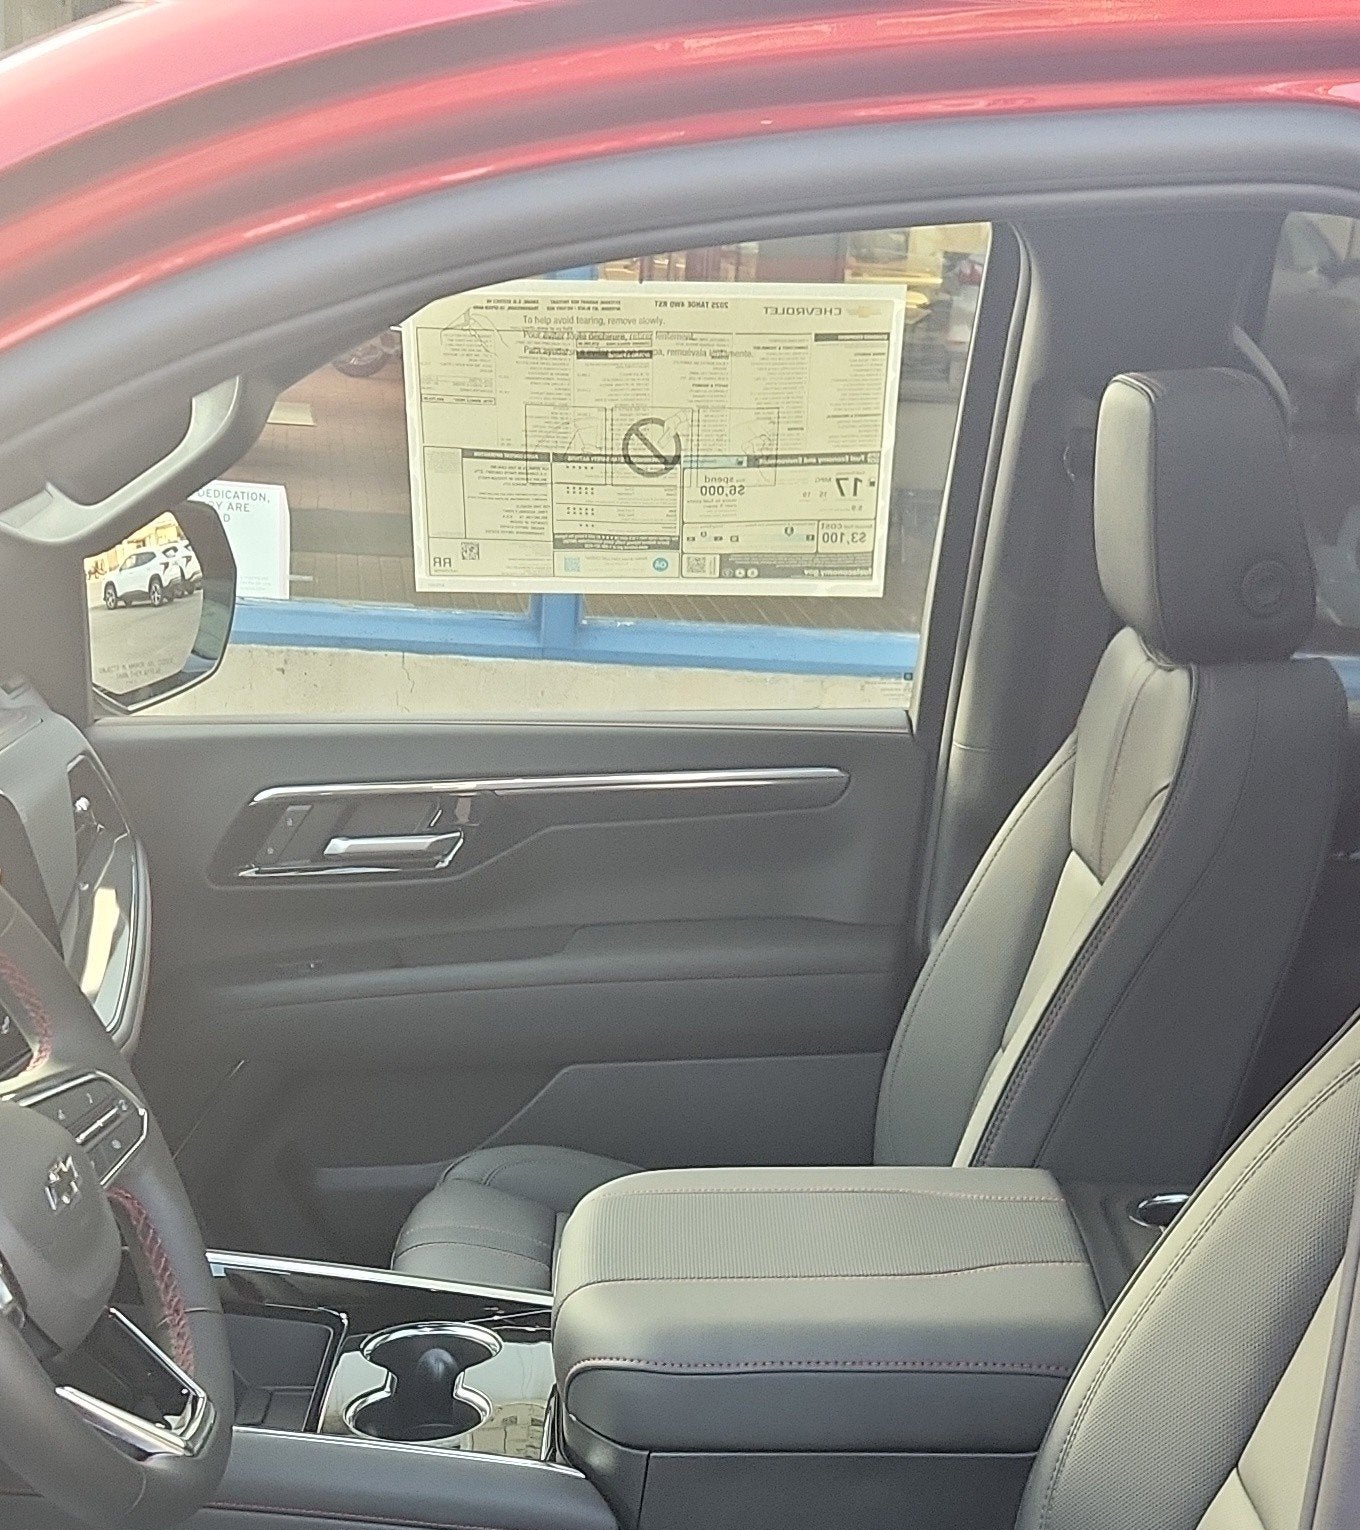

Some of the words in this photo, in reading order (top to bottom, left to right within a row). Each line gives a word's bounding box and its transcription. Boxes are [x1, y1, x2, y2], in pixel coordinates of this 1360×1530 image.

[523, 315, 533, 325] To
[534, 315, 552, 327] help
[553, 315, 575, 325] avoid
[576, 315, 605, 327] tearing,
[607, 316, 638, 326] remove
[639, 315, 665, 327] slowly.
[227, 502, 250, 512] ARE
